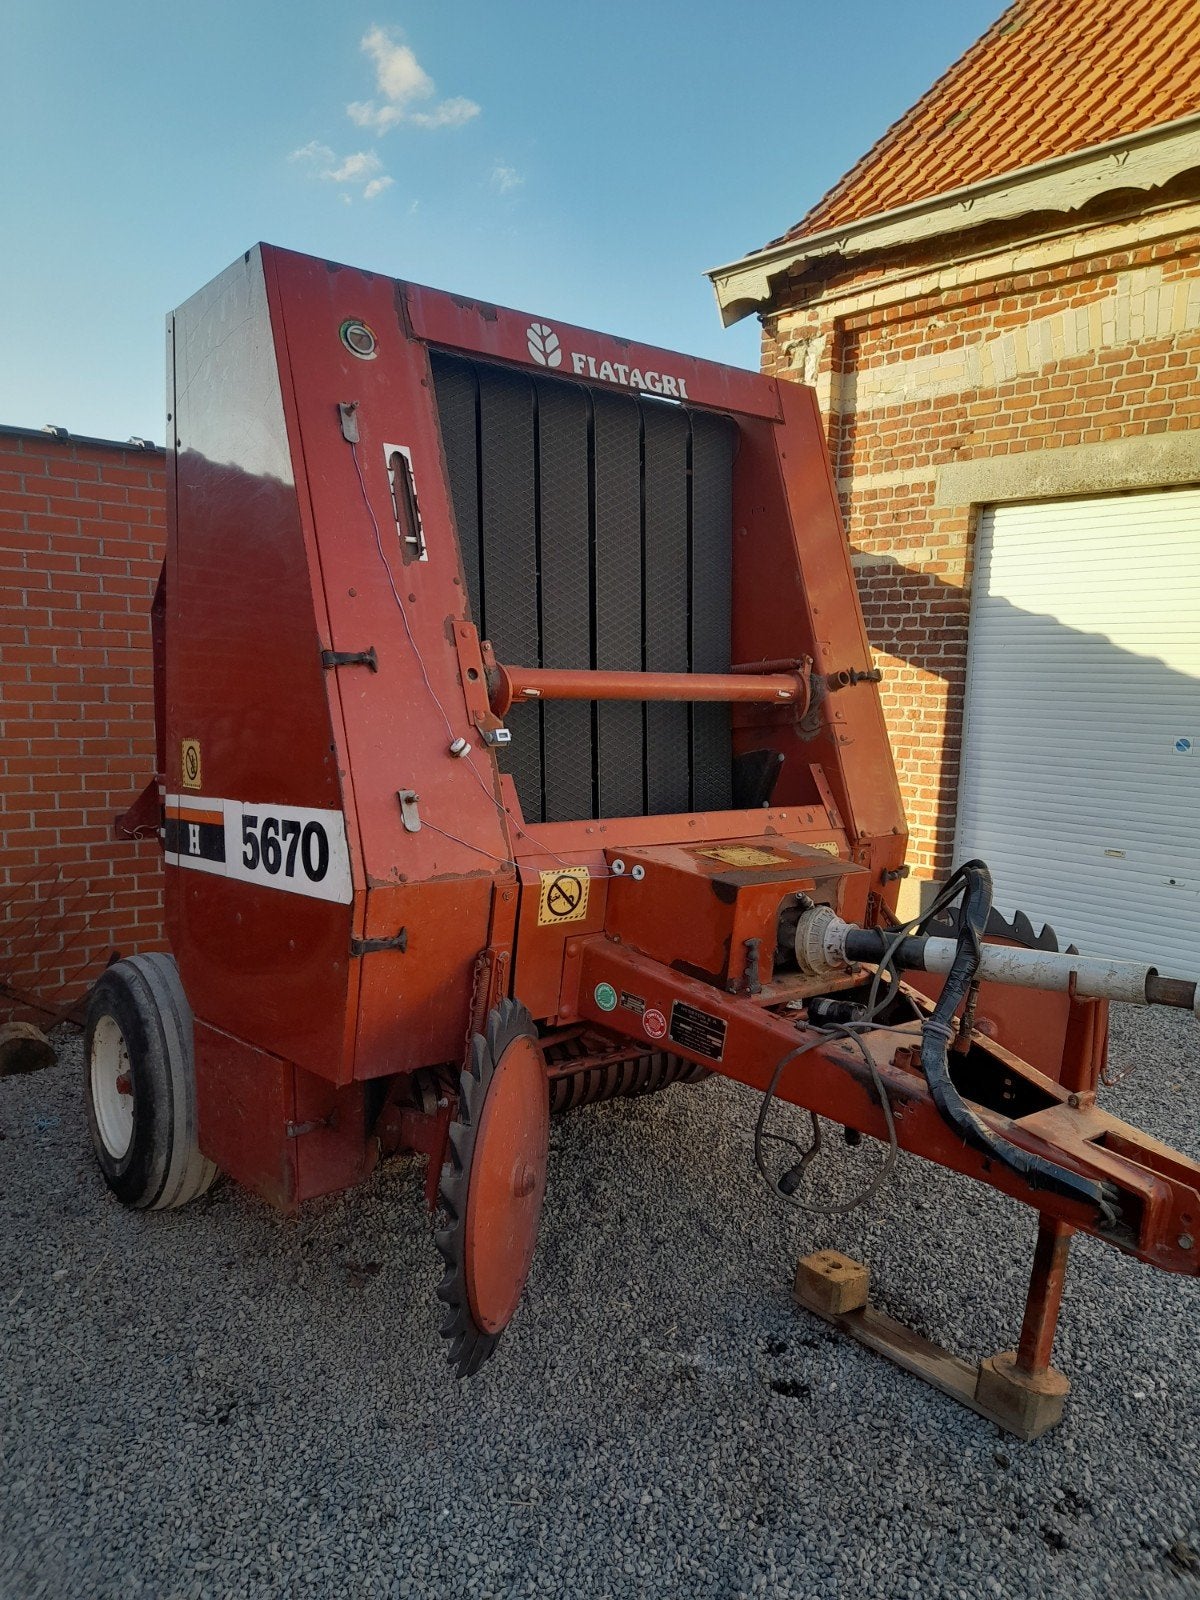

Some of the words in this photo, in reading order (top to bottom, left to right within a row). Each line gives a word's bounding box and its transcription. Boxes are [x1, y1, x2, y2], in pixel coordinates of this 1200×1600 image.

[571, 353, 688, 398] FIATAGRI
[189, 824, 201, 855] H
[242, 814, 329, 882] 5670
